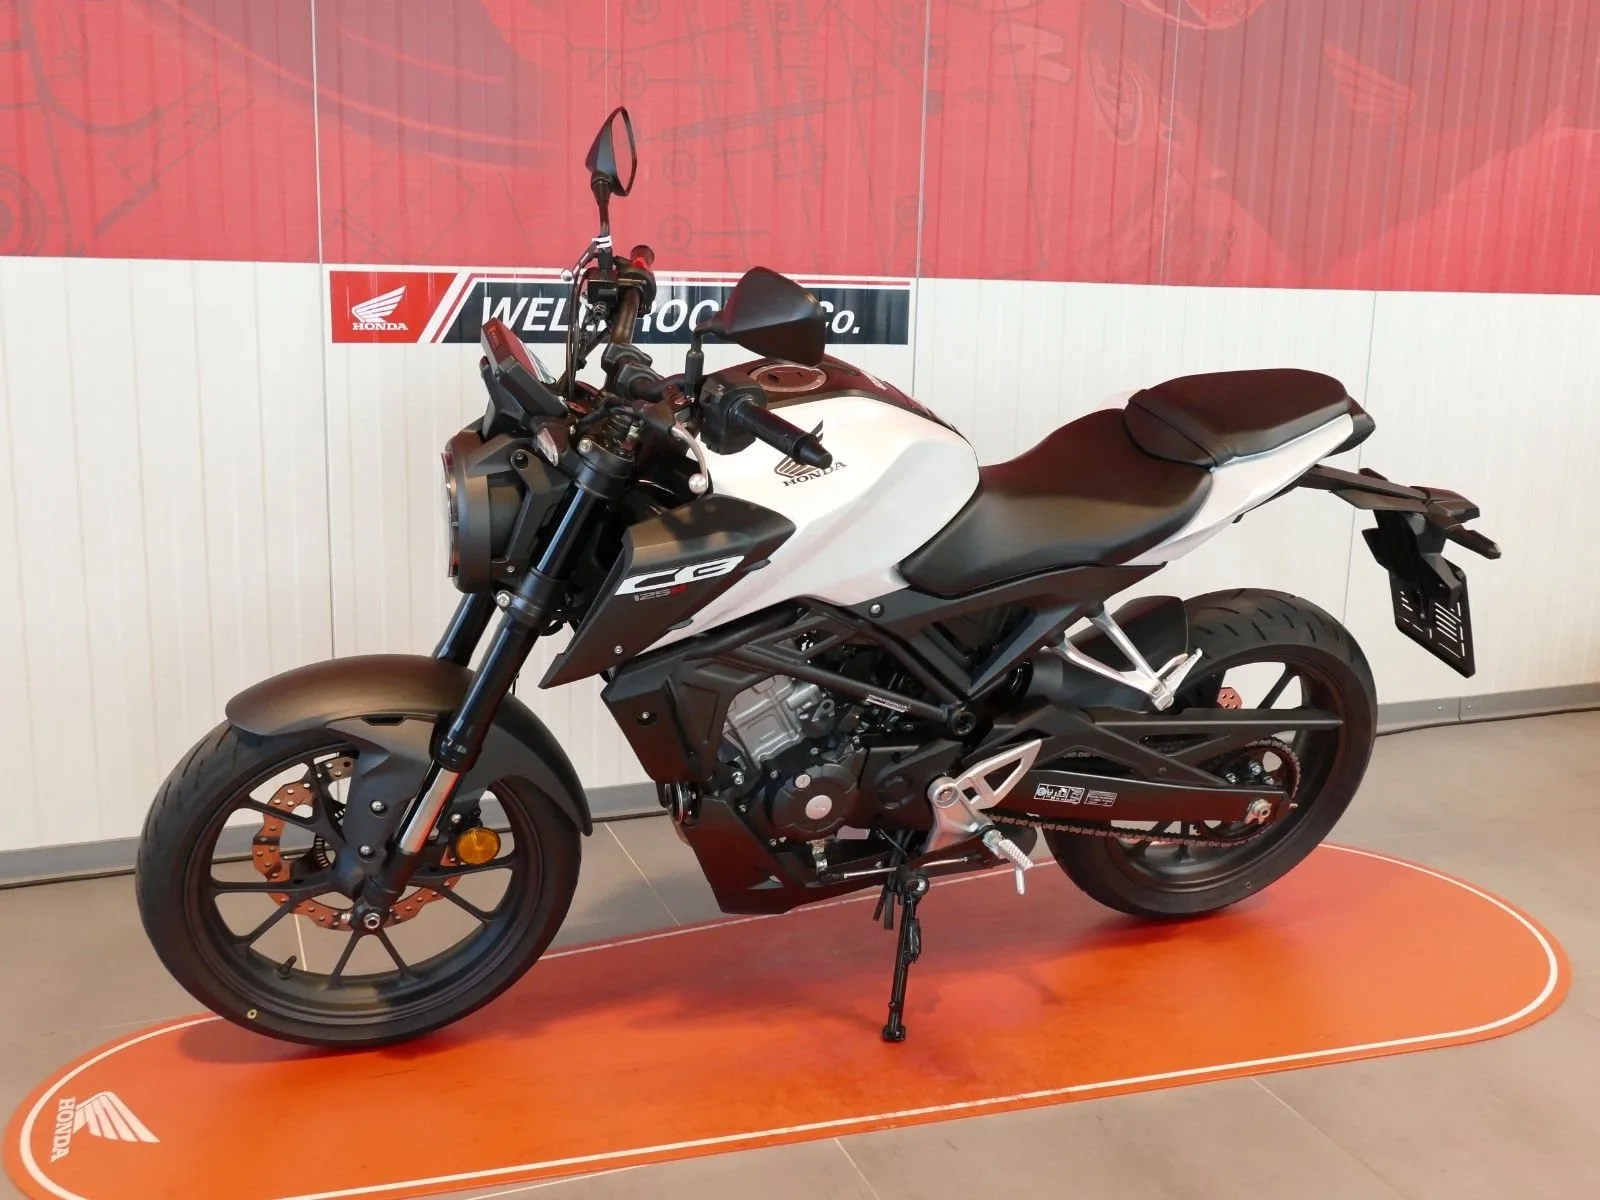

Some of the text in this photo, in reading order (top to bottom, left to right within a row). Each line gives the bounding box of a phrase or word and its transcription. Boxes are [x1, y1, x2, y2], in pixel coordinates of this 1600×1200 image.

[352, 322, 409, 331] HONDA
[781, 461, 849, 487] HONDA
[614, 555, 745, 596] CB
[50, 1096, 77, 1163] HONDA
